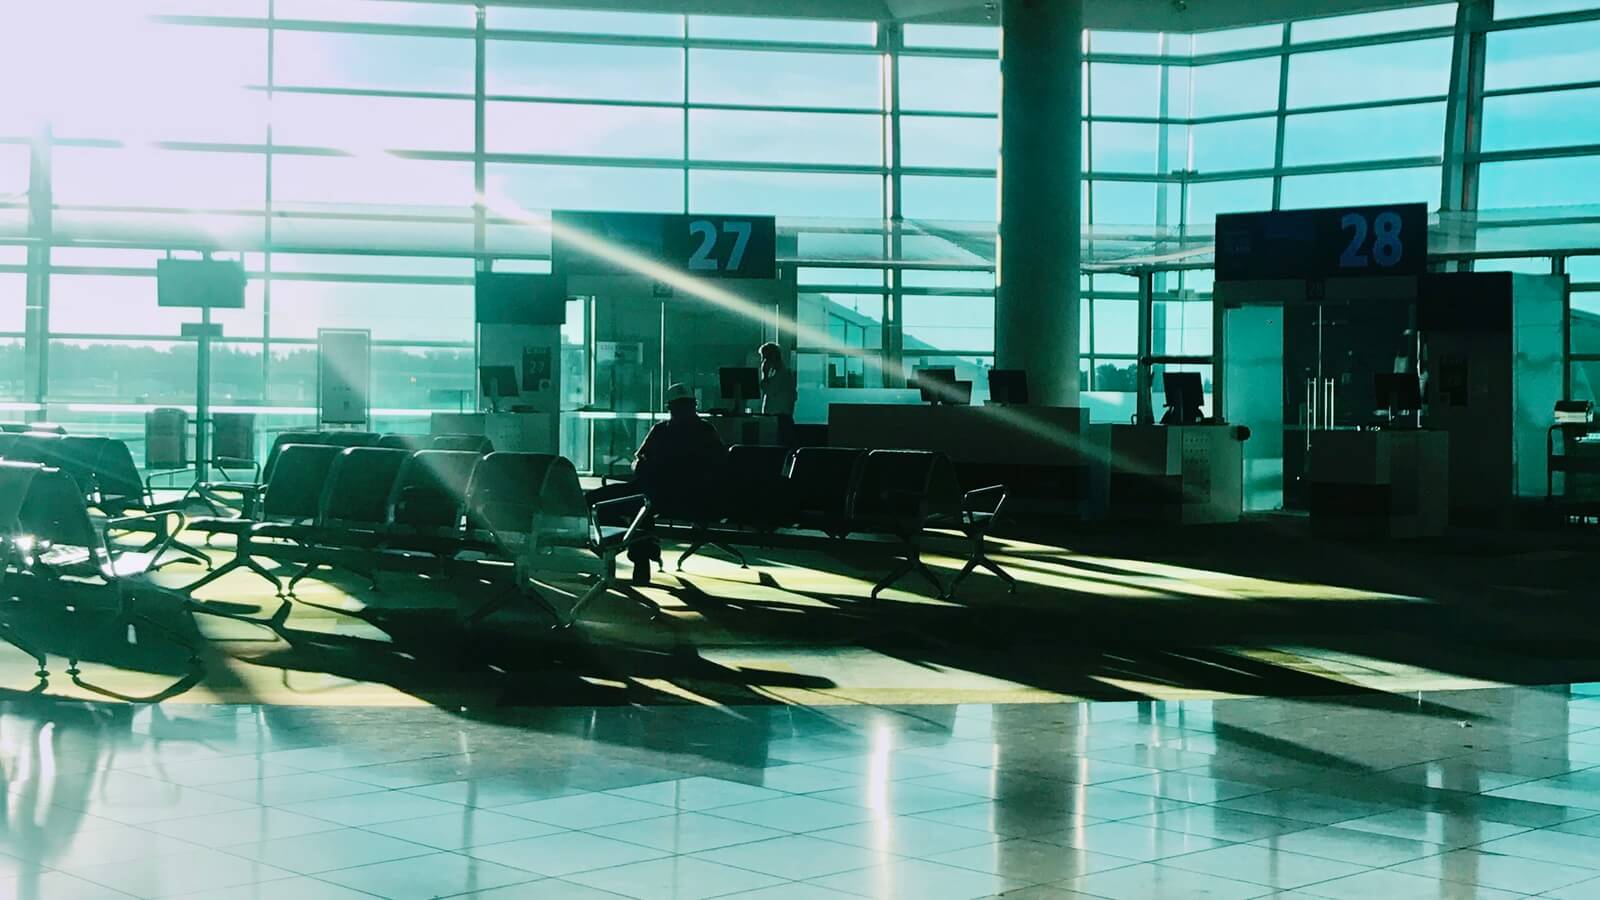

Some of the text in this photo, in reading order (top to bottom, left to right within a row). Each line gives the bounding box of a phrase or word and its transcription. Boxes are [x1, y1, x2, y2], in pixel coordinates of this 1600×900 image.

[689, 220, 752, 270] 27
[1340, 212, 1402, 267] 28
[529, 360, 545, 375] 27
